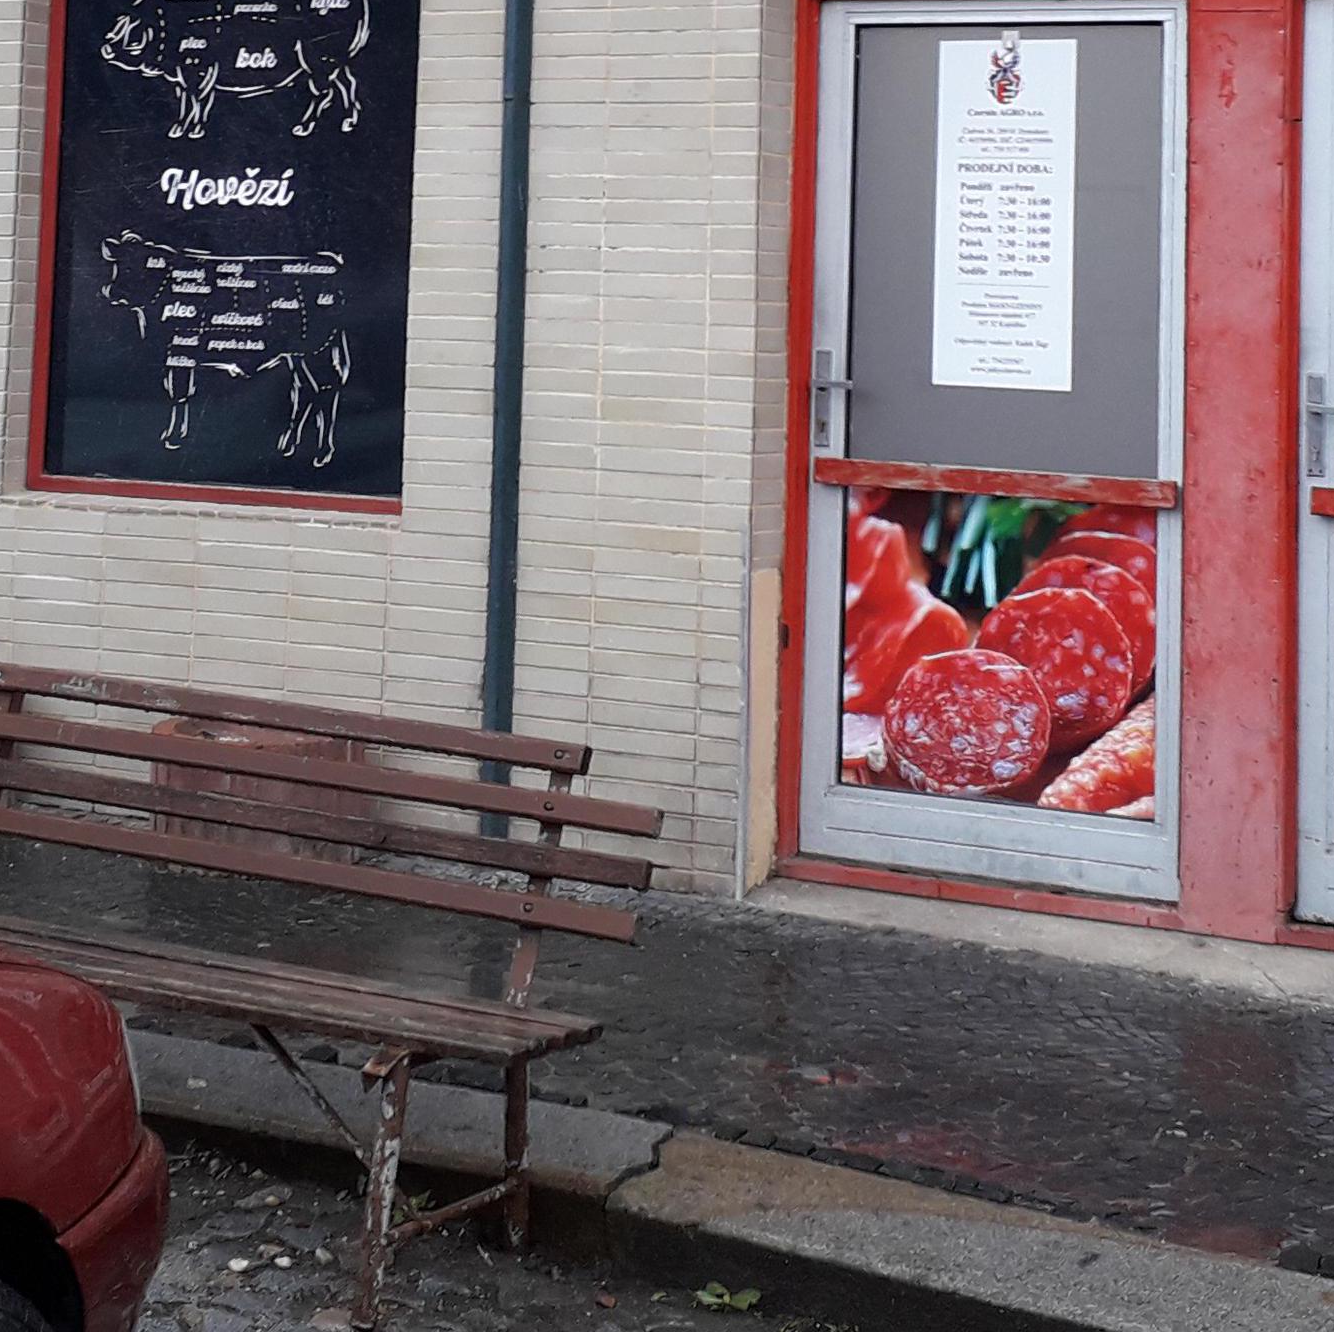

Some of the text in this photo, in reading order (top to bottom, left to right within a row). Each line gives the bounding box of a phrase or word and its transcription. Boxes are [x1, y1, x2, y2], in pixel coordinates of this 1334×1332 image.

[178, 35, 209, 53] plec
[234, 46, 278, 69] bok
[958, 161, 1054, 174] PRODEJNÍ DOBA:
[159, 166, 296, 211] Hovězí
[160, 300, 198, 321] plec
